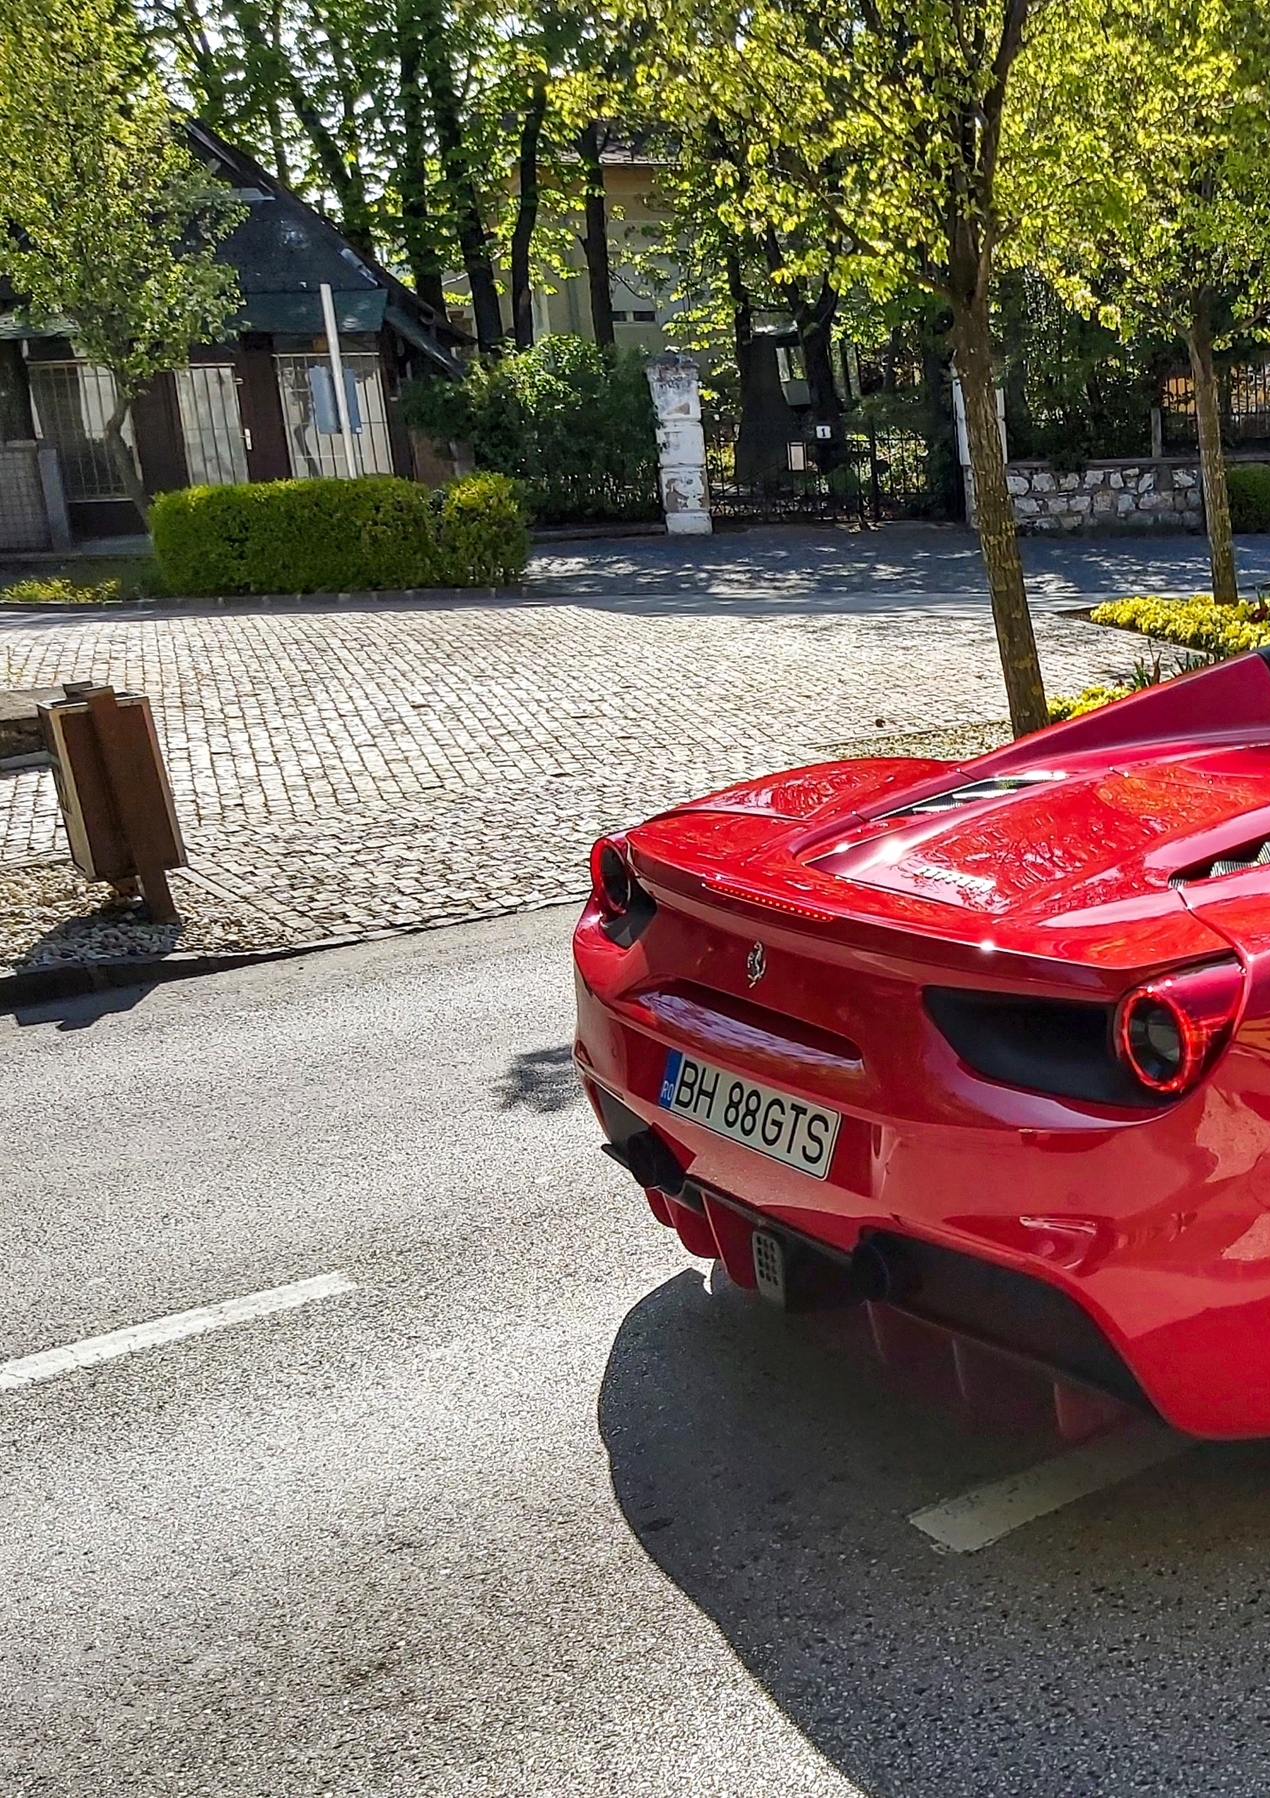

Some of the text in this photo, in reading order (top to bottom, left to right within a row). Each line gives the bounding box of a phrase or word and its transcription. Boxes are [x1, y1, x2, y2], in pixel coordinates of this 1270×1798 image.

[820, 427, 827, 438] 1
[660, 1080, 674, 1101] RO
[674, 1059, 720, 1120] BH
